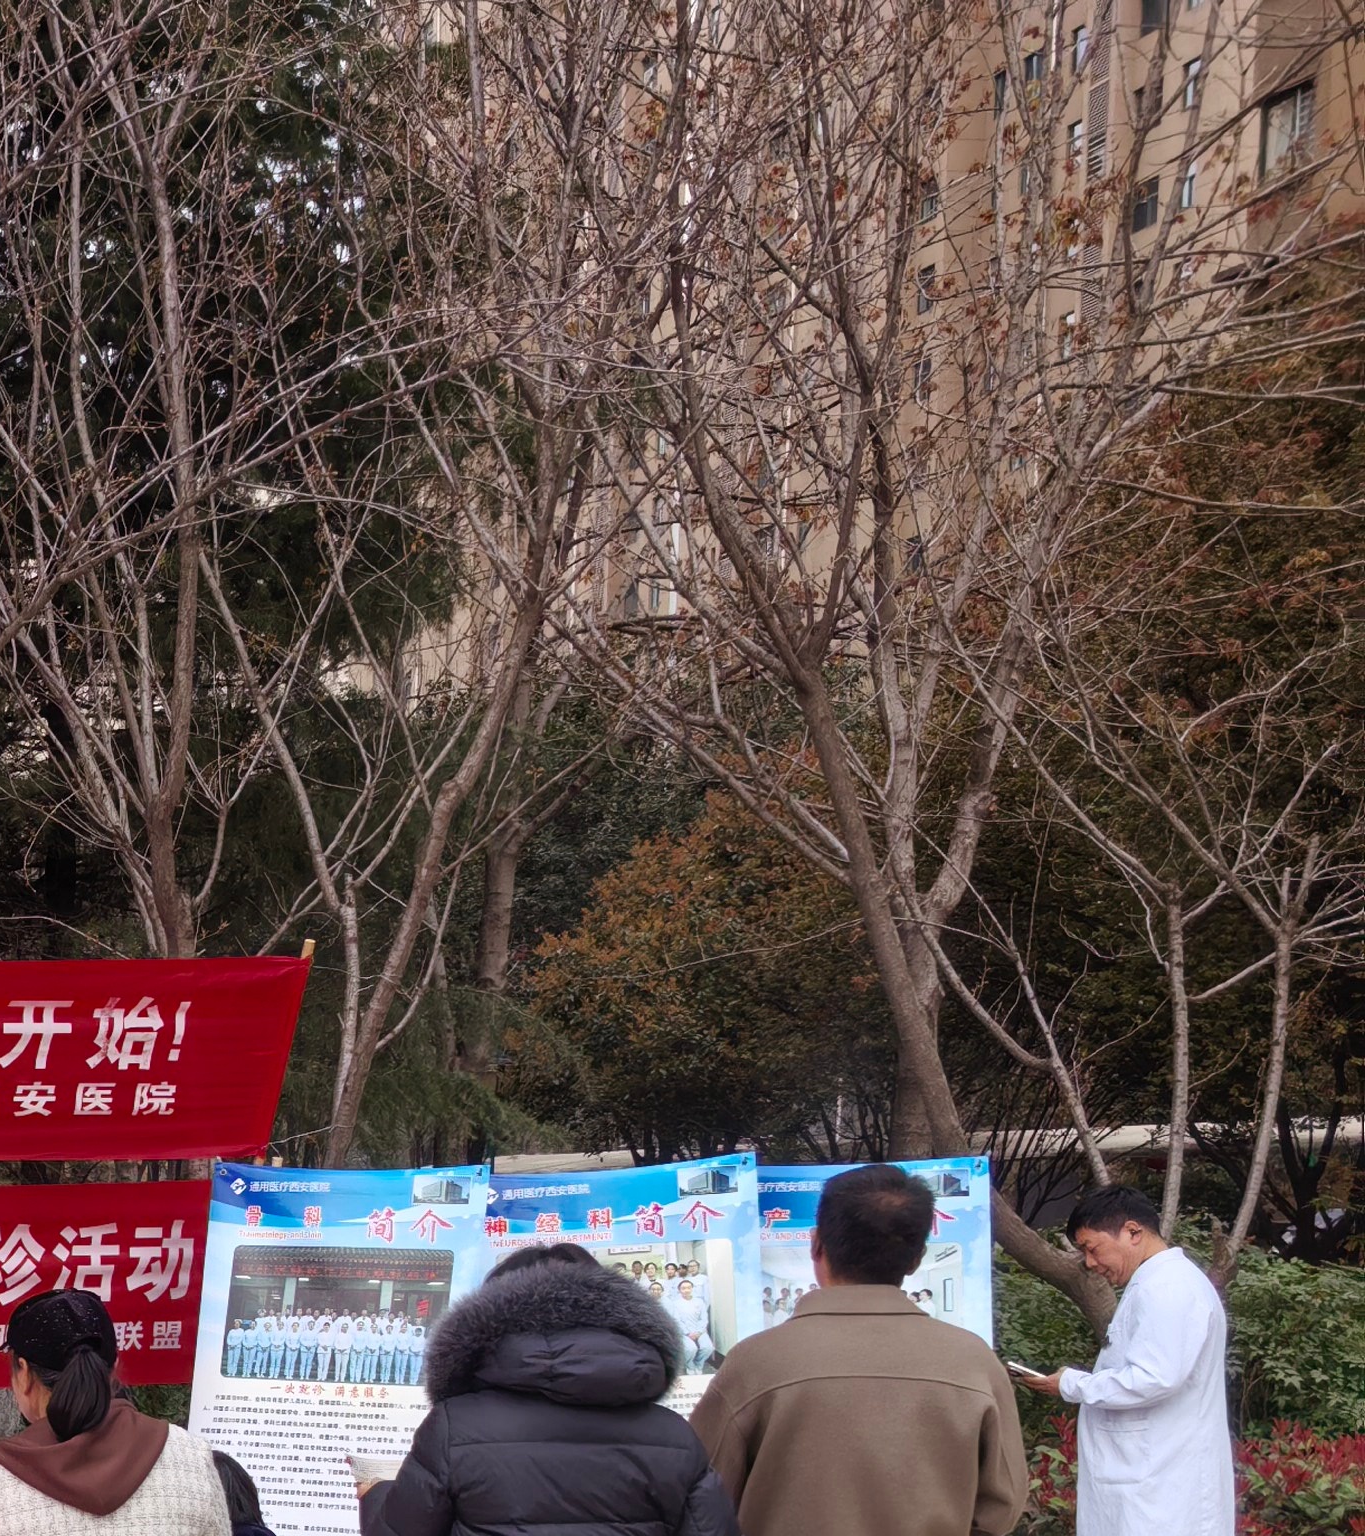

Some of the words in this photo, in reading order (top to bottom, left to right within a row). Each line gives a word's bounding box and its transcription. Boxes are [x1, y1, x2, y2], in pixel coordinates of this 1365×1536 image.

[249, 1180, 331, 1194] 通用医疗西安医院
[502, 1183, 591, 1201] 通用医疗西安医院
[368, 1207, 454, 1244] 简介
[484, 1207, 612, 1237] 神经科
[635, 1200, 725, 1238] 简介
